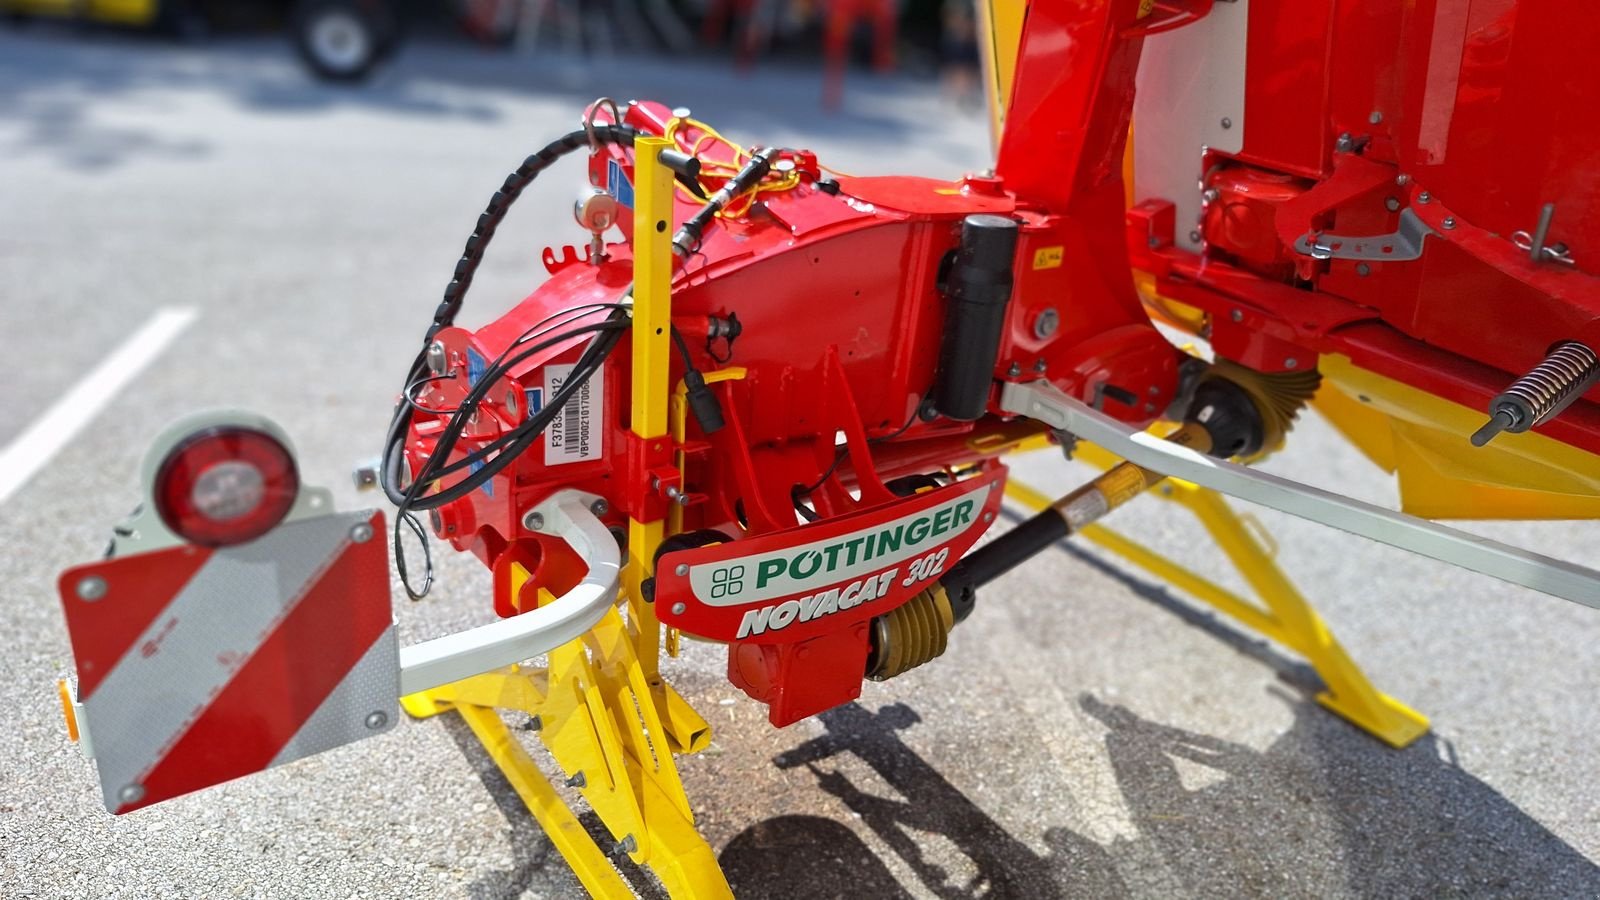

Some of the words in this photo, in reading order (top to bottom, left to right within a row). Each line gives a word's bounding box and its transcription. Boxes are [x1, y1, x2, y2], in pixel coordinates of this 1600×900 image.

[756, 499, 974, 589] PÖTTINGER
[735, 568, 900, 640] NOVACAT
[902, 547, 950, 588] 302
